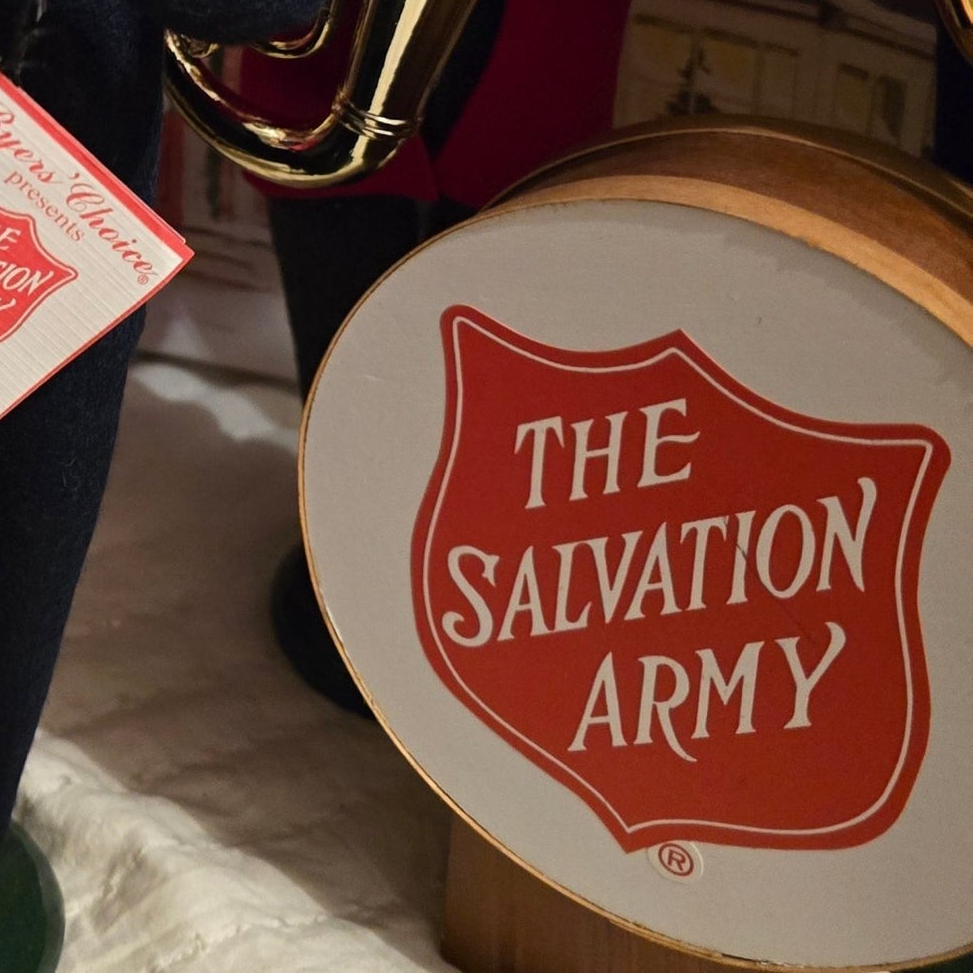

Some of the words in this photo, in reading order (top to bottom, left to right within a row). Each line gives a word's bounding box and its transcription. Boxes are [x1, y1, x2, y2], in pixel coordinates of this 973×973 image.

[4, 171, 85, 243] presents
[514, 398, 700, 510] THE
[442, 476, 877, 648] SALVATION
[567, 621, 847, 762] ARMY
